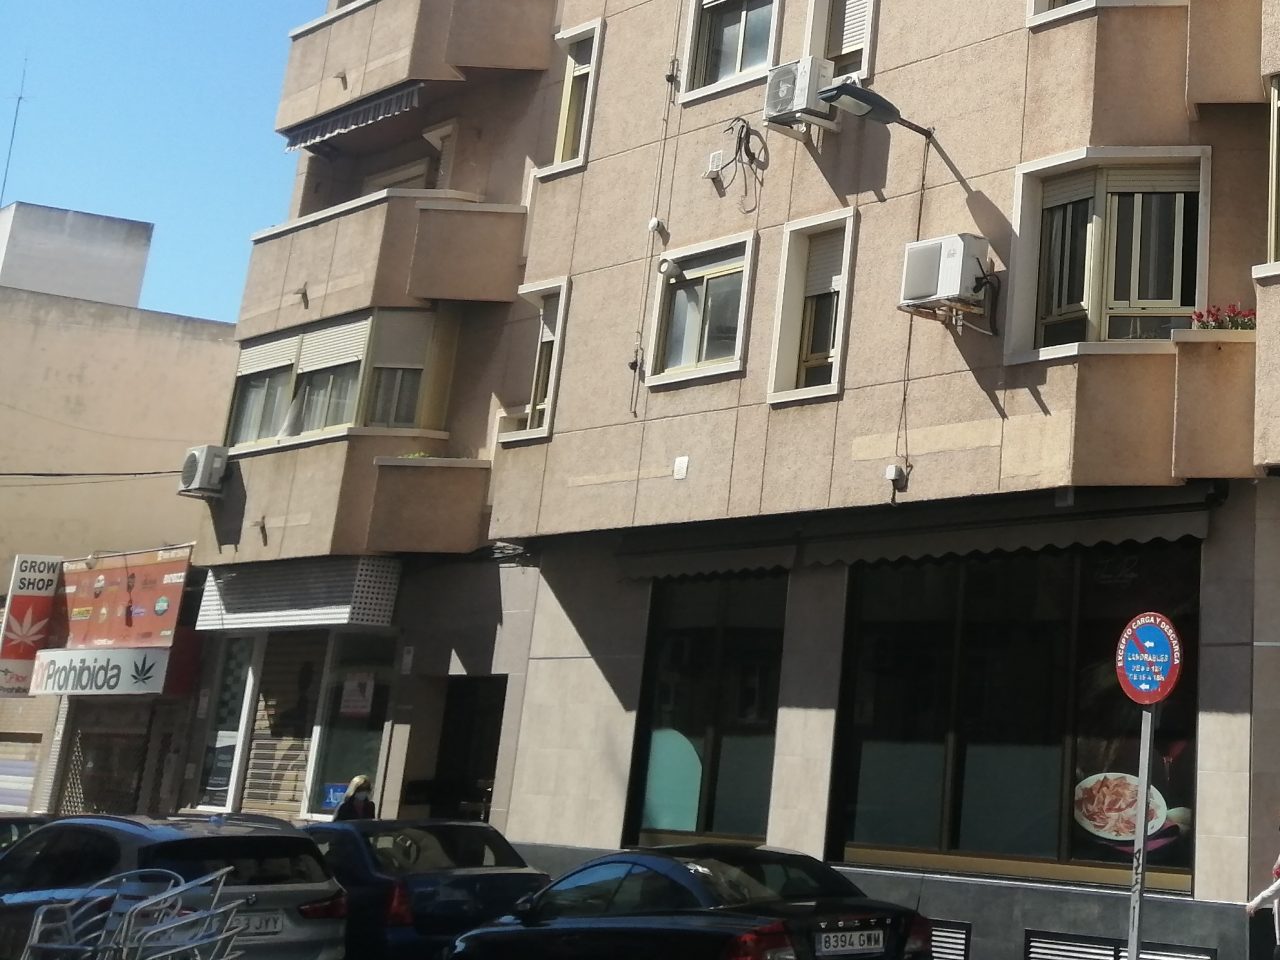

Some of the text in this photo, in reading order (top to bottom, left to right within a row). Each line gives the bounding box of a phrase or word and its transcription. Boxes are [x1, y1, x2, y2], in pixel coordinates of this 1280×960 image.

[19, 559, 59, 574] GROW
[18, 577, 54, 591] SHOP
[1117, 628, 1133, 667] EXCEPTO
[1131, 616, 1155, 630] CARGA
[1160, 621, 1180, 665] DESCARGA
[45, 658, 122, 690] Prohibida
[823, 933, 855, 950] 8394
